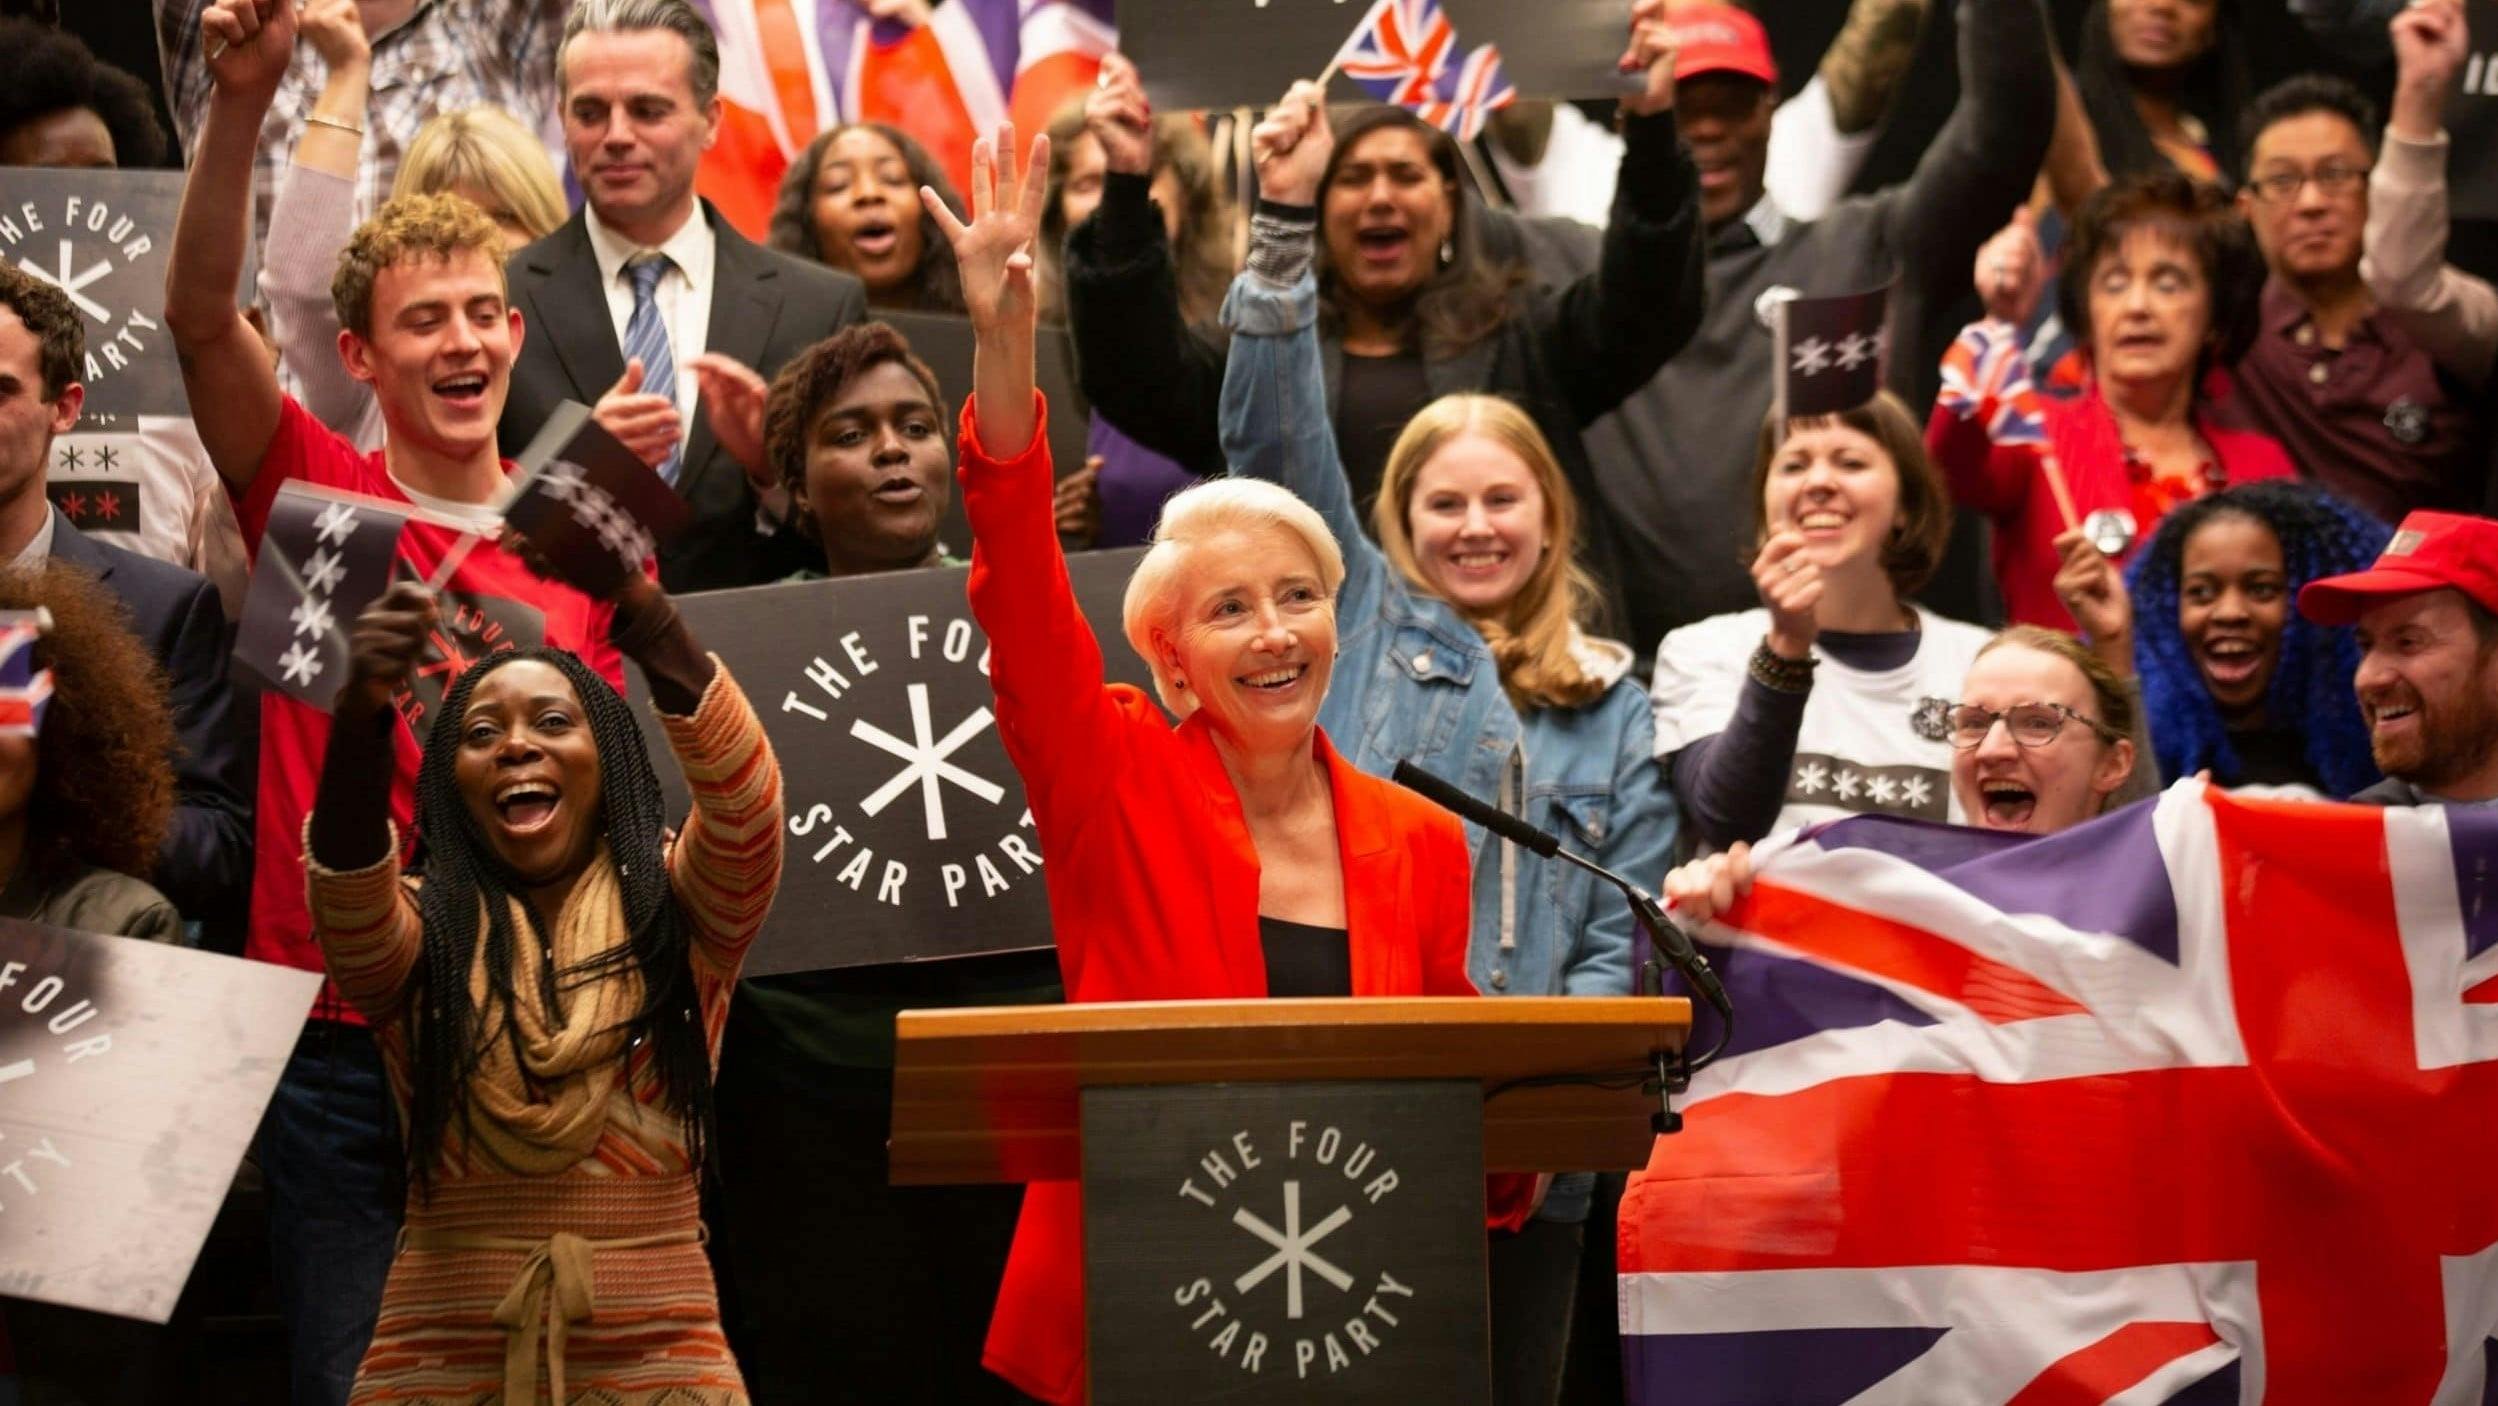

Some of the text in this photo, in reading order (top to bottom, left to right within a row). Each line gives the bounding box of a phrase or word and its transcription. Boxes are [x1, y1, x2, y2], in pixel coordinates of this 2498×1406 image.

[0, 195, 152, 263] HE FOUR
[84, 308, 158, 382] ARTY
[782, 615, 991, 721] THE FO
[789, 803, 1044, 908] STAR PAR
[0, 961, 112, 1065] FOUR
[1179, 1121, 1399, 1207] THE FOUR
[1174, 1270, 1414, 1379] STAR PARTY
